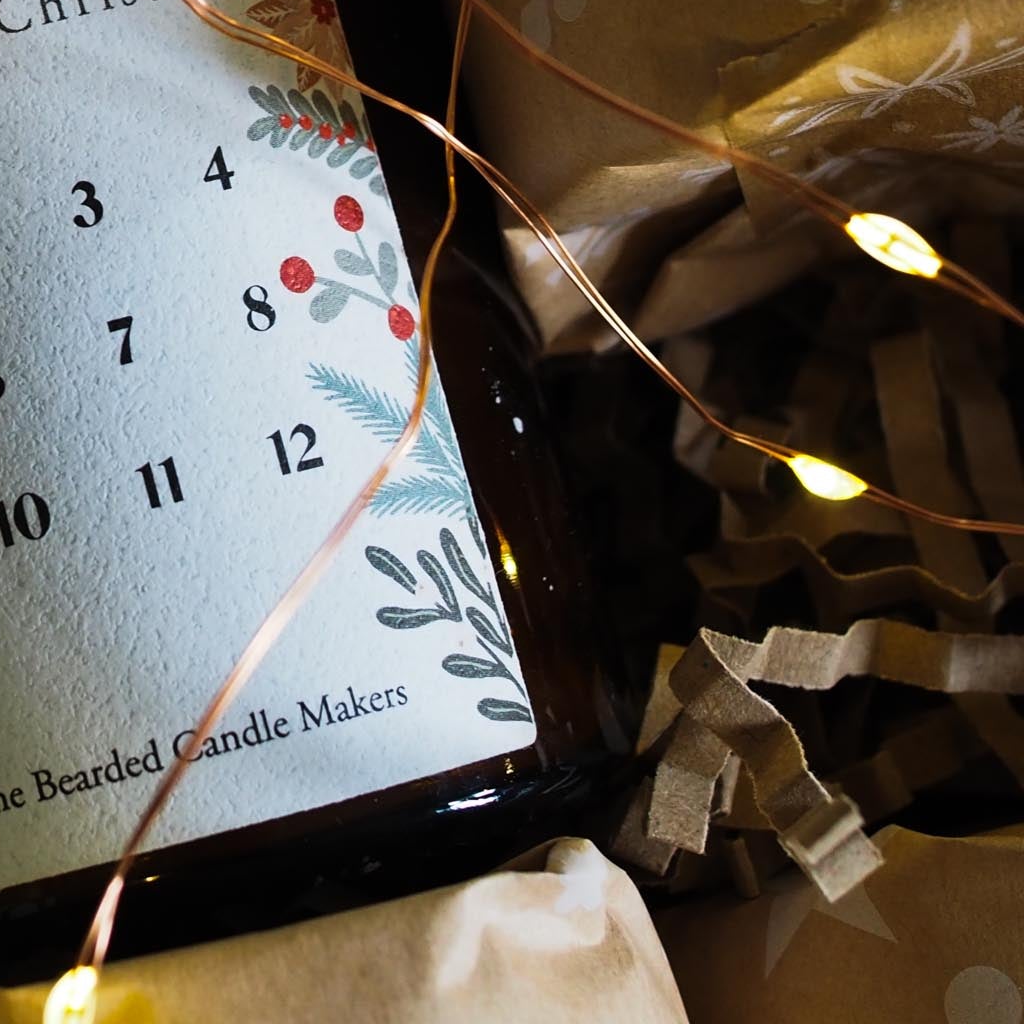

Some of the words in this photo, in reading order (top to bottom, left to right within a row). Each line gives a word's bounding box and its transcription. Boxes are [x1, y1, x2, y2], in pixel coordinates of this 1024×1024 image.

[71, 180, 104, 228] 3
[203, 145, 235, 191] 4
[106, 315, 134, 366] 7
[242, 284, 276, 332] 8
[135, 456, 184, 509] 11
[267, 423, 324, 476] 12
[30, 737, 165, 803] Bearded
[171, 708, 291, 763] Candle
[295, 684, 409, 733] Makers
